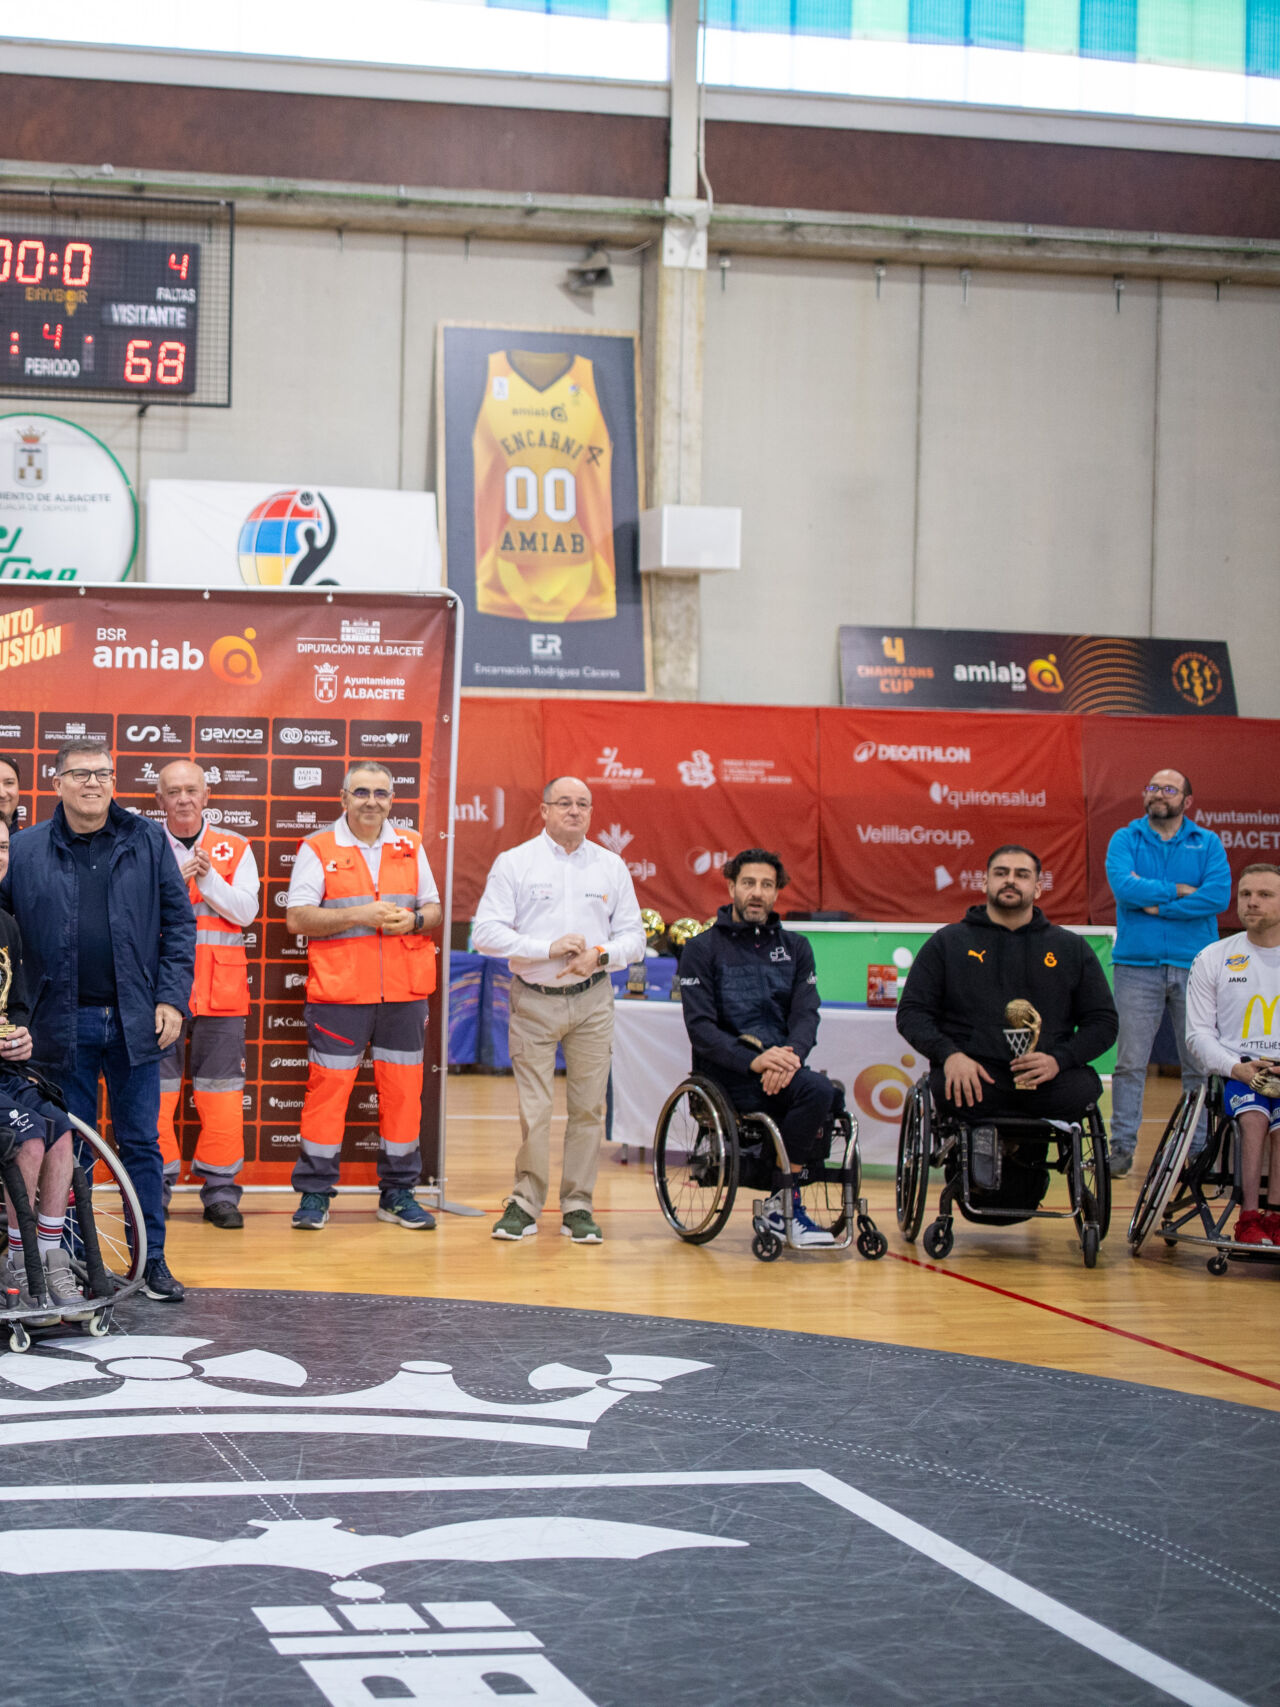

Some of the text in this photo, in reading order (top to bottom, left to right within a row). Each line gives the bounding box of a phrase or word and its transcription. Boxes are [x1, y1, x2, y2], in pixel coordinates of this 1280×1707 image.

[168, 252, 190, 280] 4
[155, 286, 197, 304] FALTAS
[110, 304, 187, 328] VISITANTE
[42, 322, 64, 350] 4
[24, 357, 81, 378] PERIODO
[124, 339, 187, 385] 68
[500, 429, 584, 460] ENCARNI
[37, 493, 51, 502] DE
[55, 493, 112, 503] ALBACETE
[504, 465, 577, 523] 00
[500, 530, 586, 555] AMIAB
[96, 627, 128, 642] BSR
[297, 642, 424, 657] DIPUTACIÓN DE ALBACETE
[530, 633, 563, 656] ER
[881, 635, 906, 665] 4
[92, 640, 205, 671] amiab
[856, 665, 935, 680] CHAMPIONS
[953, 660, 1027, 684] amiab
[344, 675, 406, 688] Ayuntamiento
[879, 679, 915, 694] CUP
[343, 688, 406, 701] ALBACETE
[200, 727, 264, 742] gaviota
[303, 735, 332, 744] ONCE
[145, 809, 168, 817] CASTIL
[224, 816, 252, 825] ONCE
[1195, 809, 1280, 827] Ayuntamien
[856, 824, 975, 849] VelillaGroup.
[1220, 830, 1280, 849] BACET
[284, 1017, 308, 1028] Caixa
[277, 1100, 305, 1110] quirón
